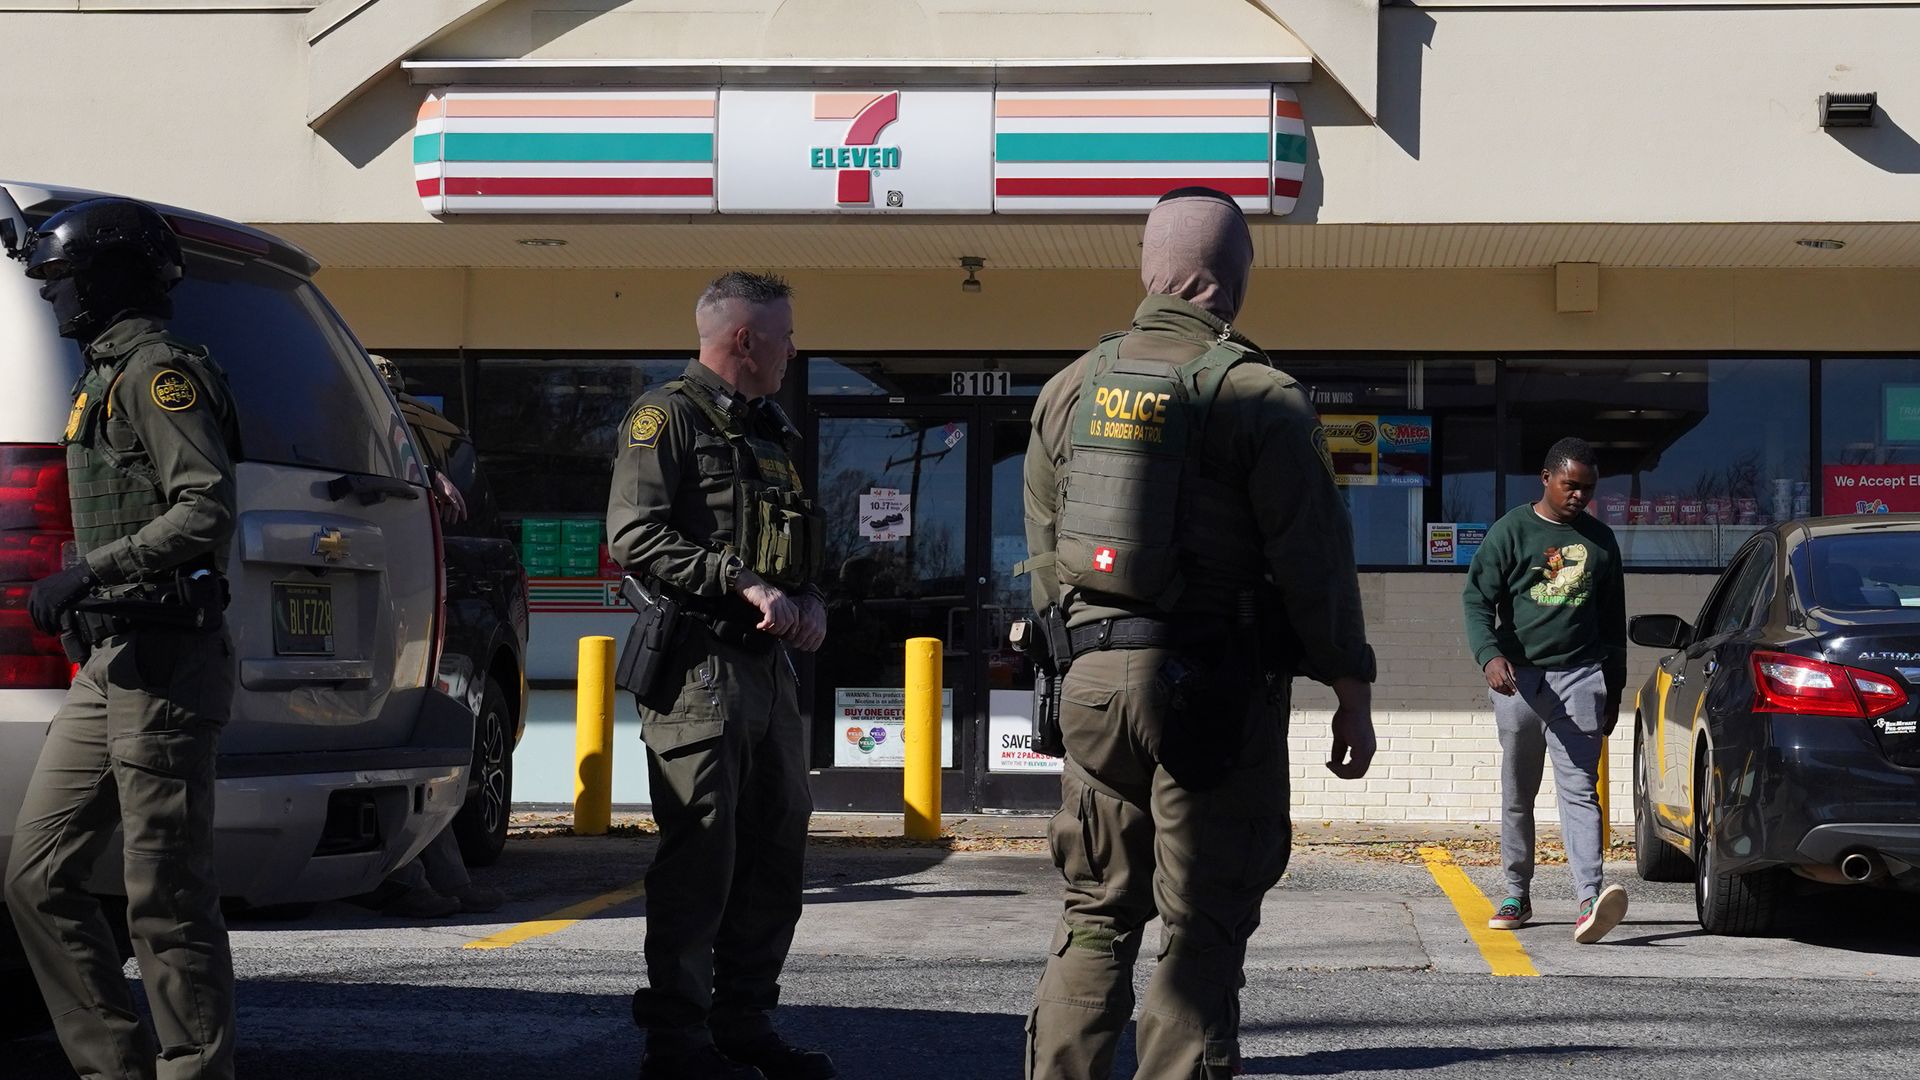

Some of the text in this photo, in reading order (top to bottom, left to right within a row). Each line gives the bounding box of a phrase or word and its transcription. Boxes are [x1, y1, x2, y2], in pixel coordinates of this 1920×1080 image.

[953, 372, 1007, 395] 8101
[1093, 387, 1171, 424] POLICE
[1090, 420, 1163, 443] U.S. BORDER PATROL
[1396, 424, 1430, 439] MEGA
[1834, 475, 1855, 486] We
[1859, 475, 1905, 489] Accept
[870, 501, 880, 510] 10
[1431, 545, 1452, 553] Card
[1858, 651, 1920, 660] ALTIMA
[883, 692, 902, 700] product
[844, 708, 862, 716] BUY
[864, 708, 882, 716] ONE
[884, 708, 901, 716] GET
[1002, 734, 1032, 748] SAVE
[1022, 751, 1045, 760] PACKS
